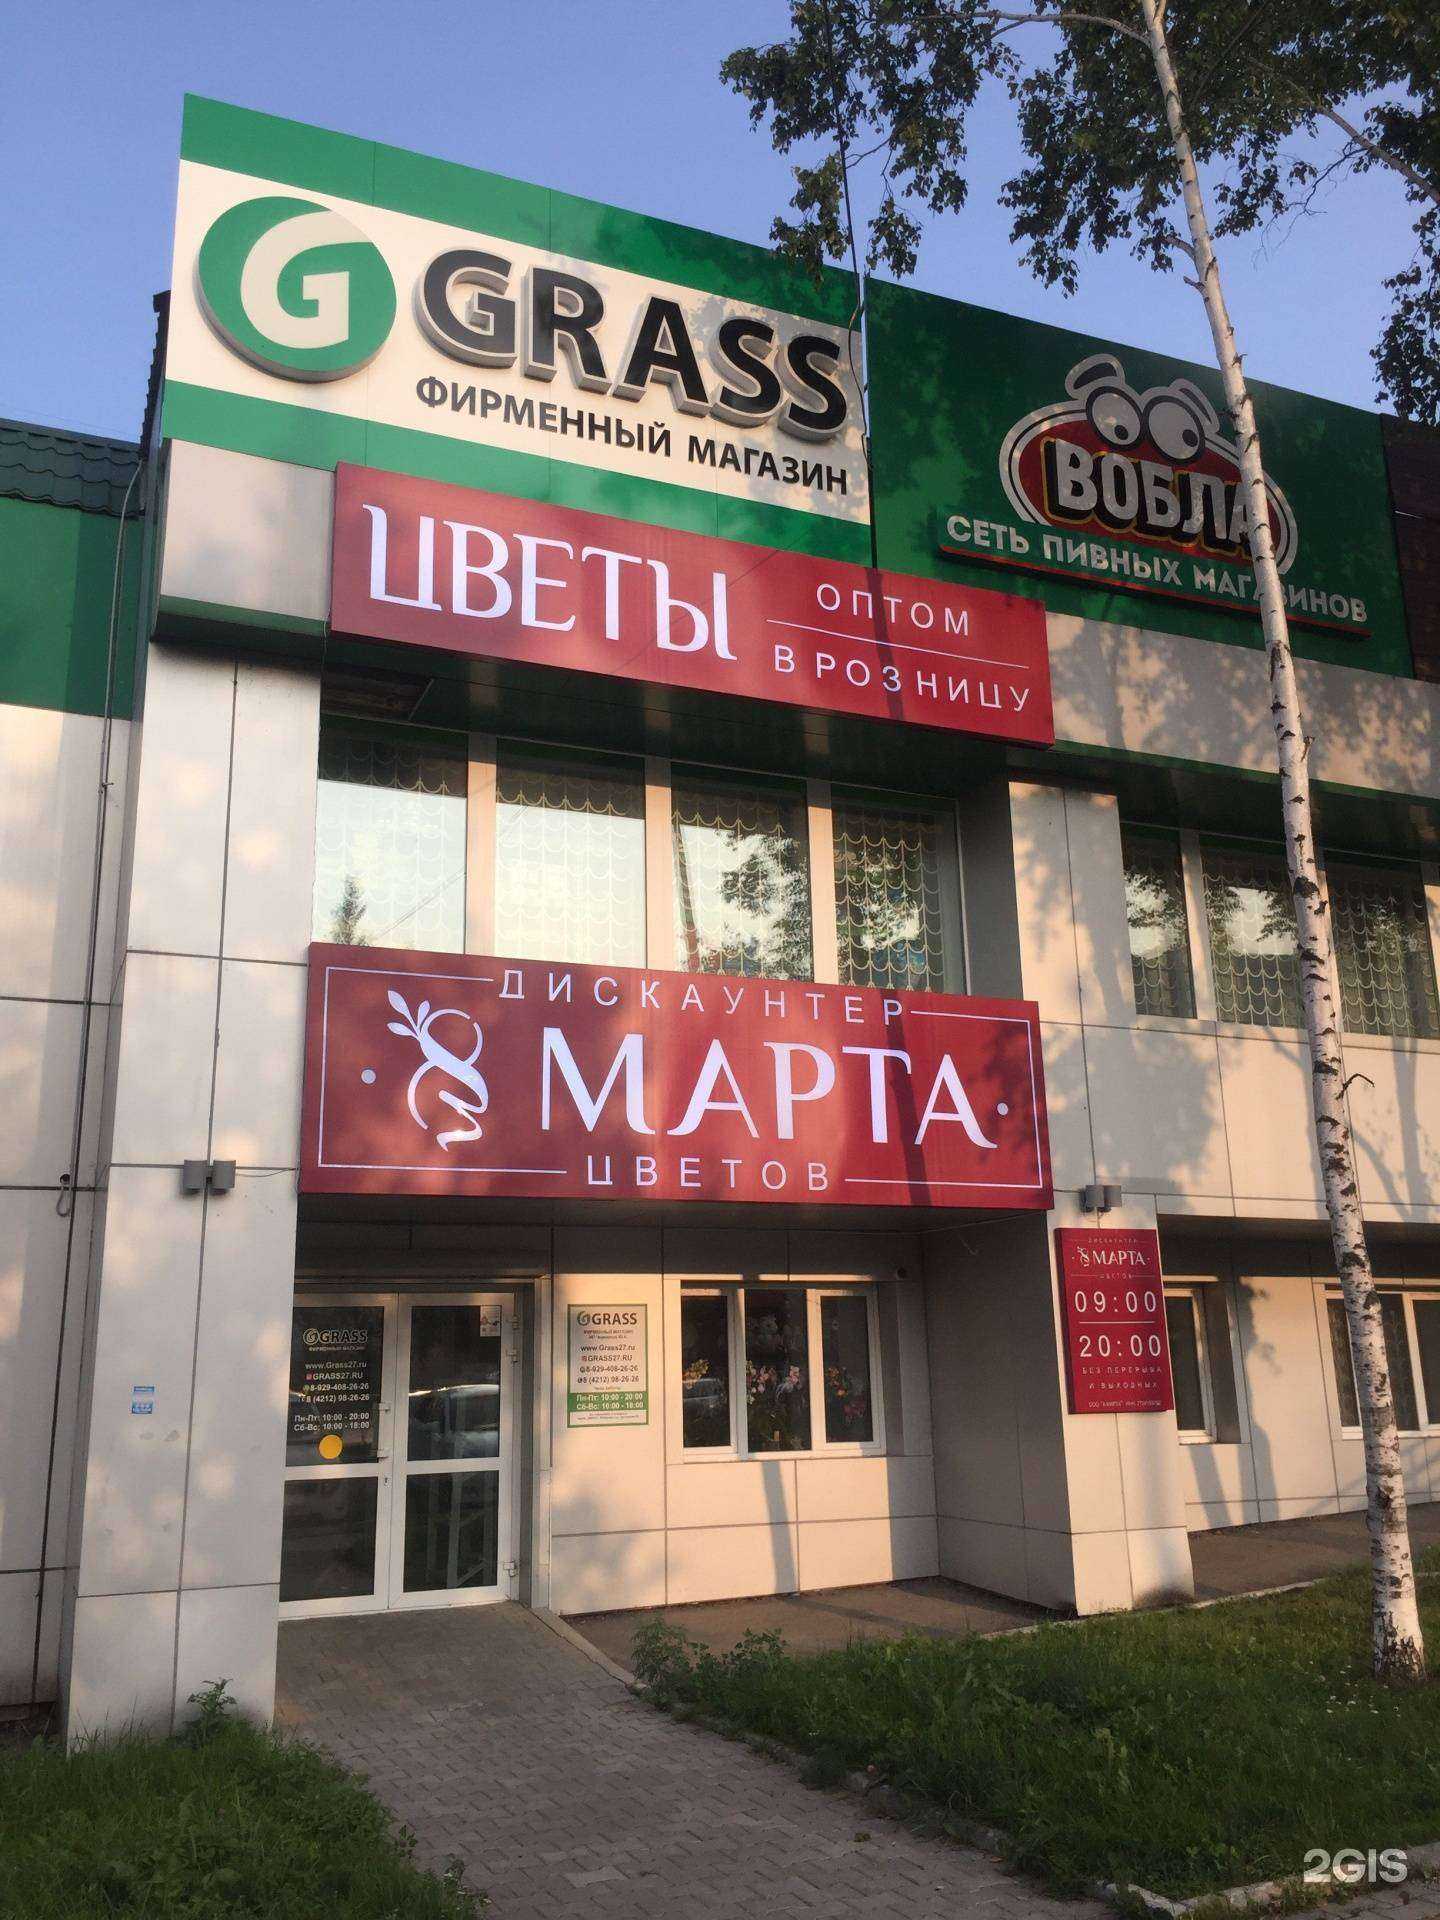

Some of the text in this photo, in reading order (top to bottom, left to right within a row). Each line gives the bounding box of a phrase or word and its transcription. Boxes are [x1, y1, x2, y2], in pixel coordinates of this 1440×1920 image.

[418, 248, 849, 434] GRASS
[416, 375, 848, 495] ФИРМЕННЫЙ МАГАЗИН
[362, 503, 738, 661] ЦВЕТЫ
[946, 514, 1367, 622] СЕТЬ ПИВНЫХ МАГИНОВ
[816, 583, 969, 636] ОПТОМ
[774, 644, 1030, 712] В РОЗНИЦУ
[499, 969, 903, 1026] ДИСКАУНТЕР
[541, 1026, 997, 1149] МАРТА
[587, 1155, 829, 1191] ЦВЕТОВ
[1092, 1250, 1147, 1265] МАРТА
[592, 1313, 637, 1325] GRASS
[1074, 1290, 1156, 1313] 09:00
[320, 1330, 368, 1344] GRASS
[1079, 1334, 1161, 1357] 20:00
